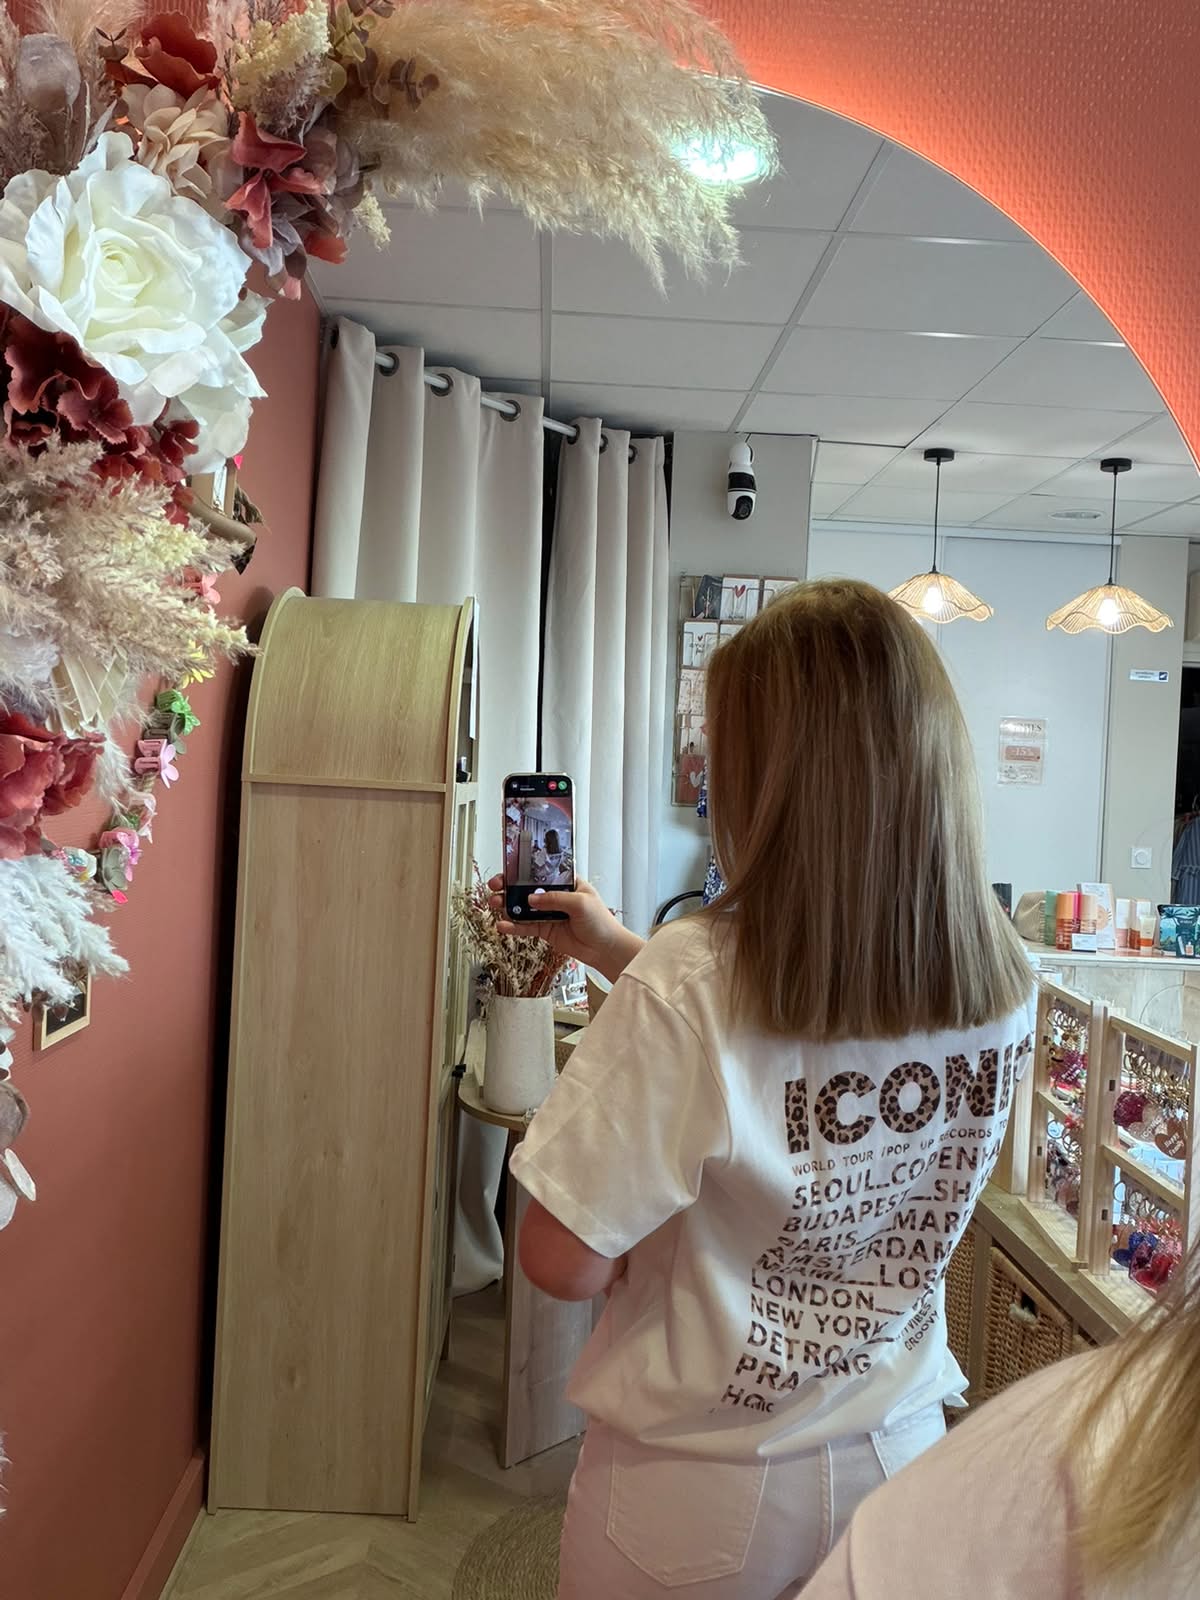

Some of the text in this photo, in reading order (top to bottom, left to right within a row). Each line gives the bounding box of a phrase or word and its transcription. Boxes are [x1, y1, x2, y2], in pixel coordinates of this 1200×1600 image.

[792, 1159, 835, 1177] WORLD
[843, 1150, 874, 1165] TOUR
[920, 1138, 934, 1149] UP
[751, 1293, 804, 1330] NEW
[814, 1312, 889, 1340] YORK
[904, 1310, 940, 1351] GROOVY
